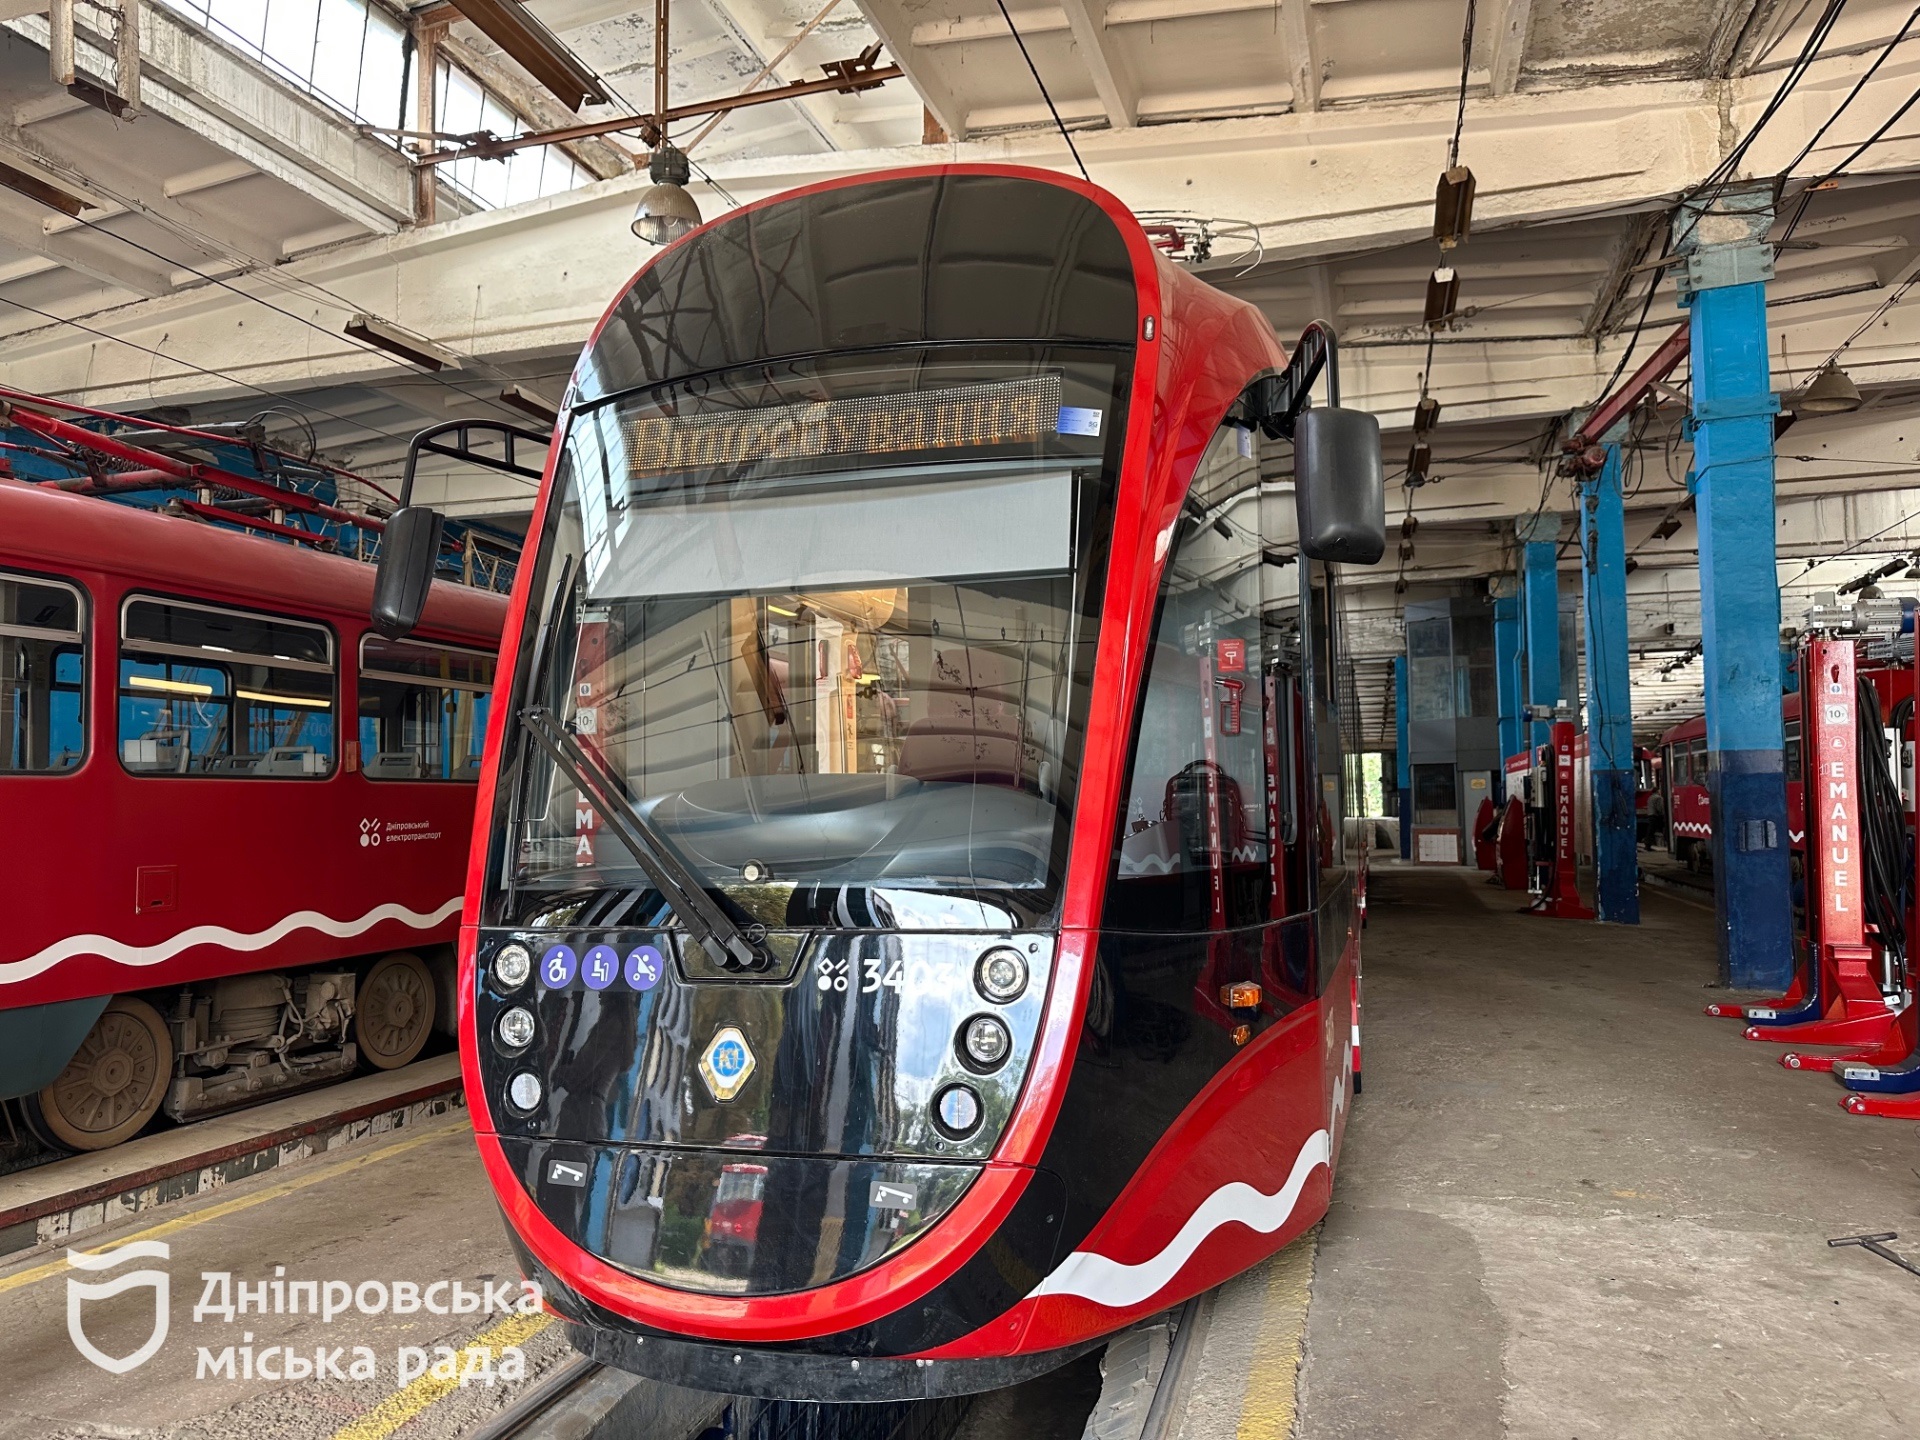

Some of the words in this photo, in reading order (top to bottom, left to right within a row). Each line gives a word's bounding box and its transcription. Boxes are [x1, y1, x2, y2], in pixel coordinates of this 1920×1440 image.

[385, 820, 430, 831] Дніпровський
[385, 832, 442, 842] електротранспорт
[1559, 784, 1570, 859] EMANUEL
[1829, 761, 1850, 913] EMANUEL
